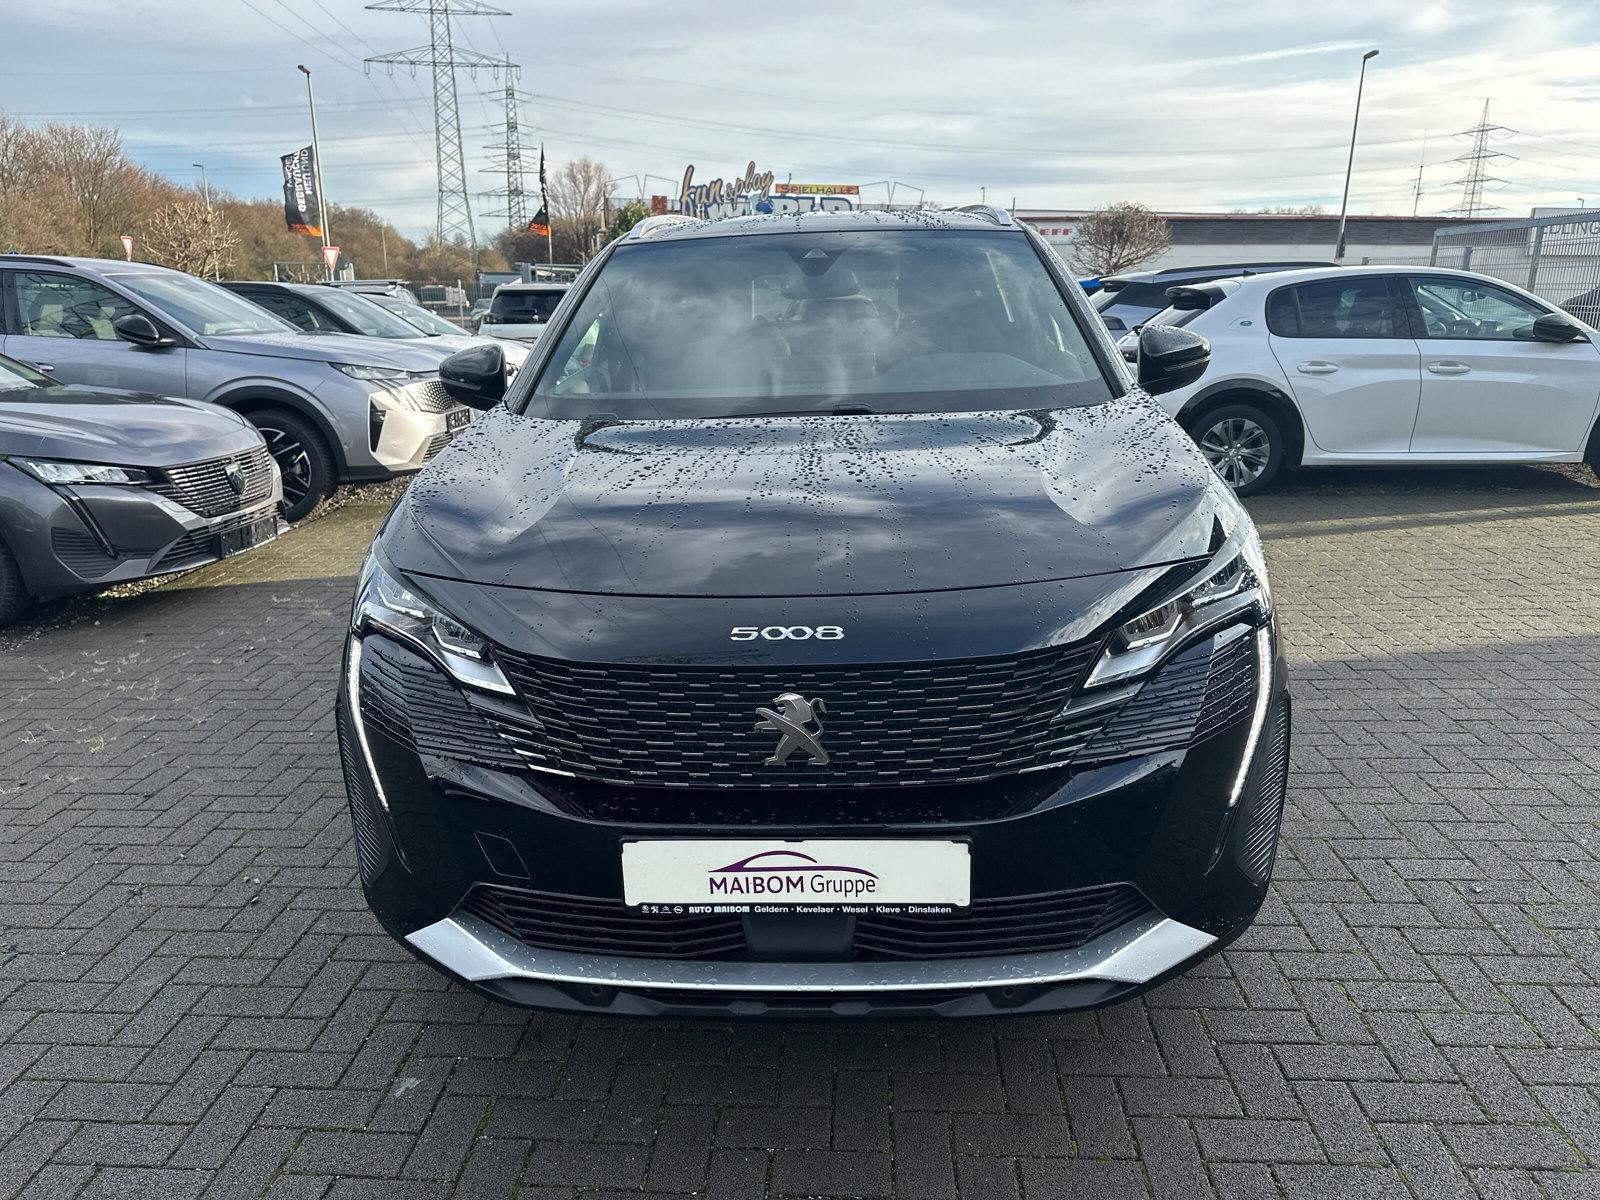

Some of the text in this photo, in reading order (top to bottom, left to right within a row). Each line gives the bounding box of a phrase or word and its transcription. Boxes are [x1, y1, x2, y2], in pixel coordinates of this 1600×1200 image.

[733, 160, 775, 211] play
[780, 184, 855, 195] SPIELHALLE
[730, 625, 845, 641] 5008
[709, 874, 877, 898] MAIBOM Gruppe
[688, 905, 952, 914] AUTO MAIBOM Geldern Kevelaer Wesel Kleve Dinslaken
